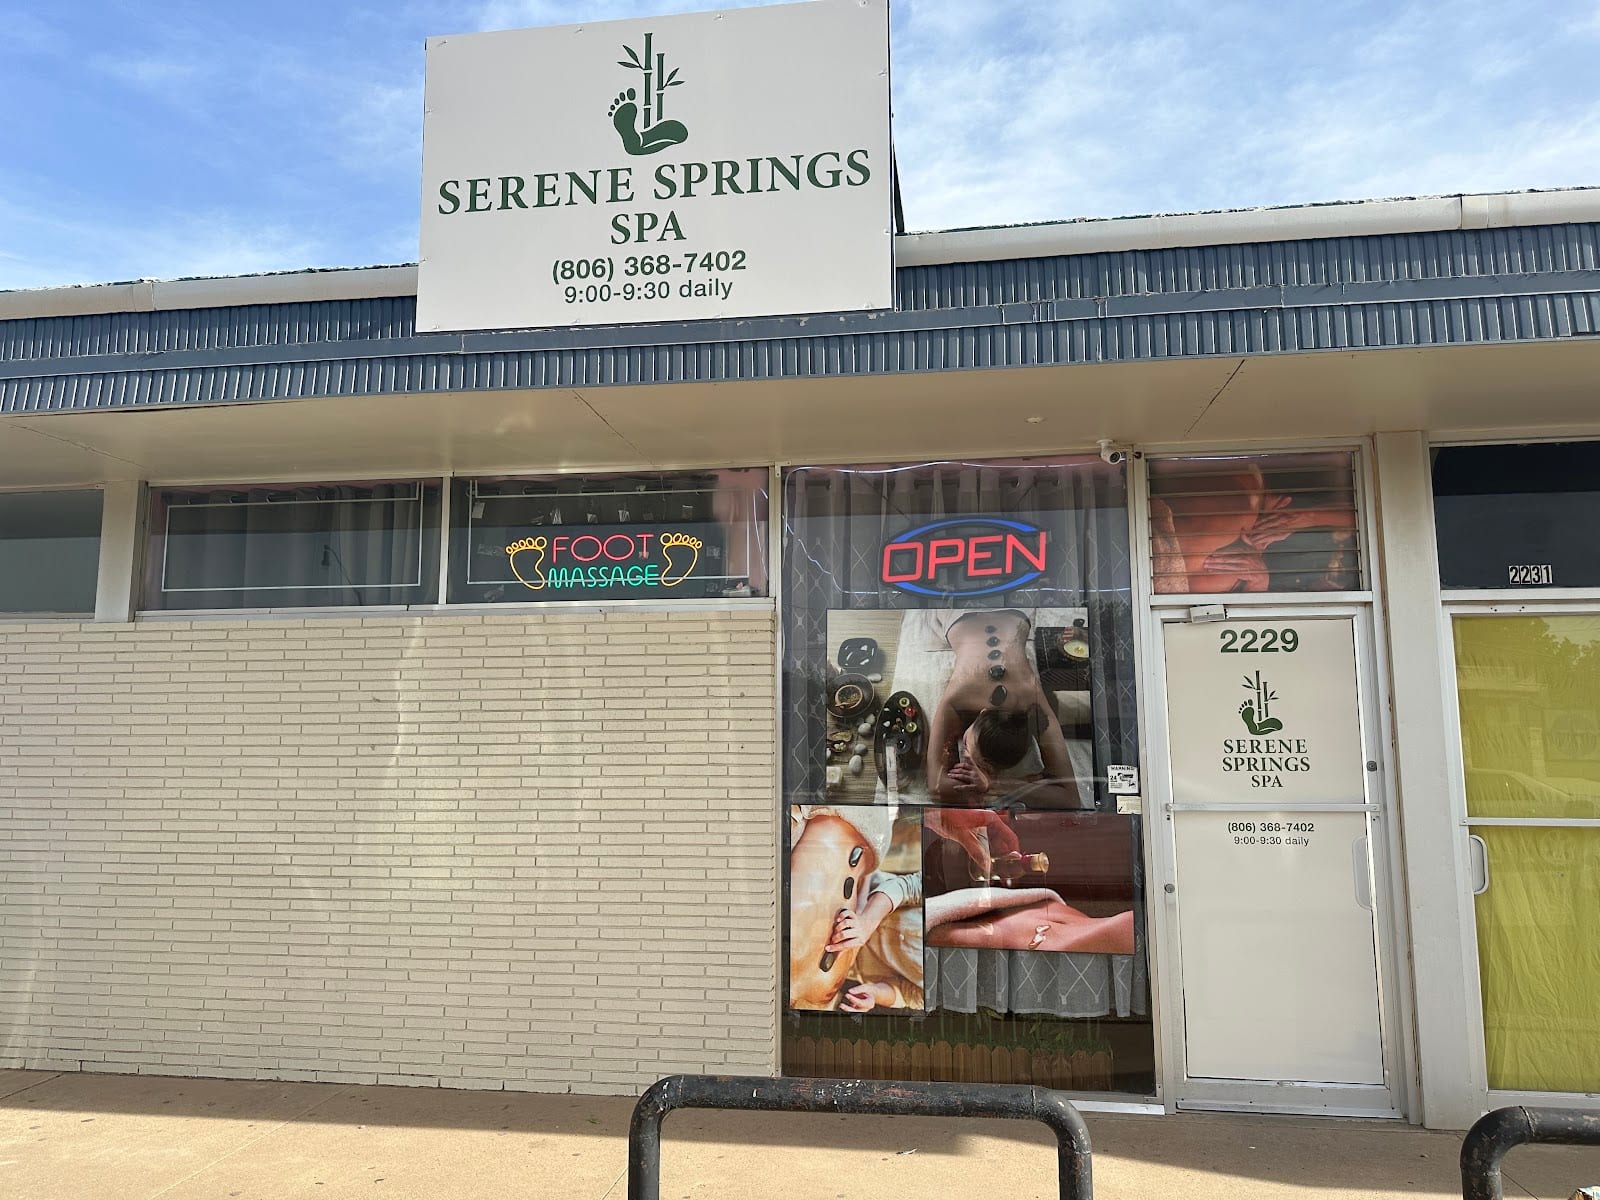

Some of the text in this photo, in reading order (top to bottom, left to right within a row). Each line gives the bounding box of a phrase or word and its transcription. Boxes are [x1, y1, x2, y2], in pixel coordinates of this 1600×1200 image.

[438, 149, 872, 215] SERENE SPRINGS
[610, 210, 687, 245] SPA
[552, 250, 747, 284] (806) 368-7402
[564, 278, 733, 303] 9:00-9:30 daily
[552, 533, 654, 564] FOOT
[882, 532, 1047, 583] OPEN
[547, 564, 660, 588] MASSAGE
[1509, 566, 1551, 583] 2231
[1220, 628, 1299, 653] 2229
[1223, 739, 1308, 754] SERENE
[1222, 757, 1310, 772] SPRINGS
[1251, 775, 1284, 788] SPA
[1227, 822, 1315, 834] (806) 368-7402
[1233, 836, 1310, 847] 9:00-9:30 daily
